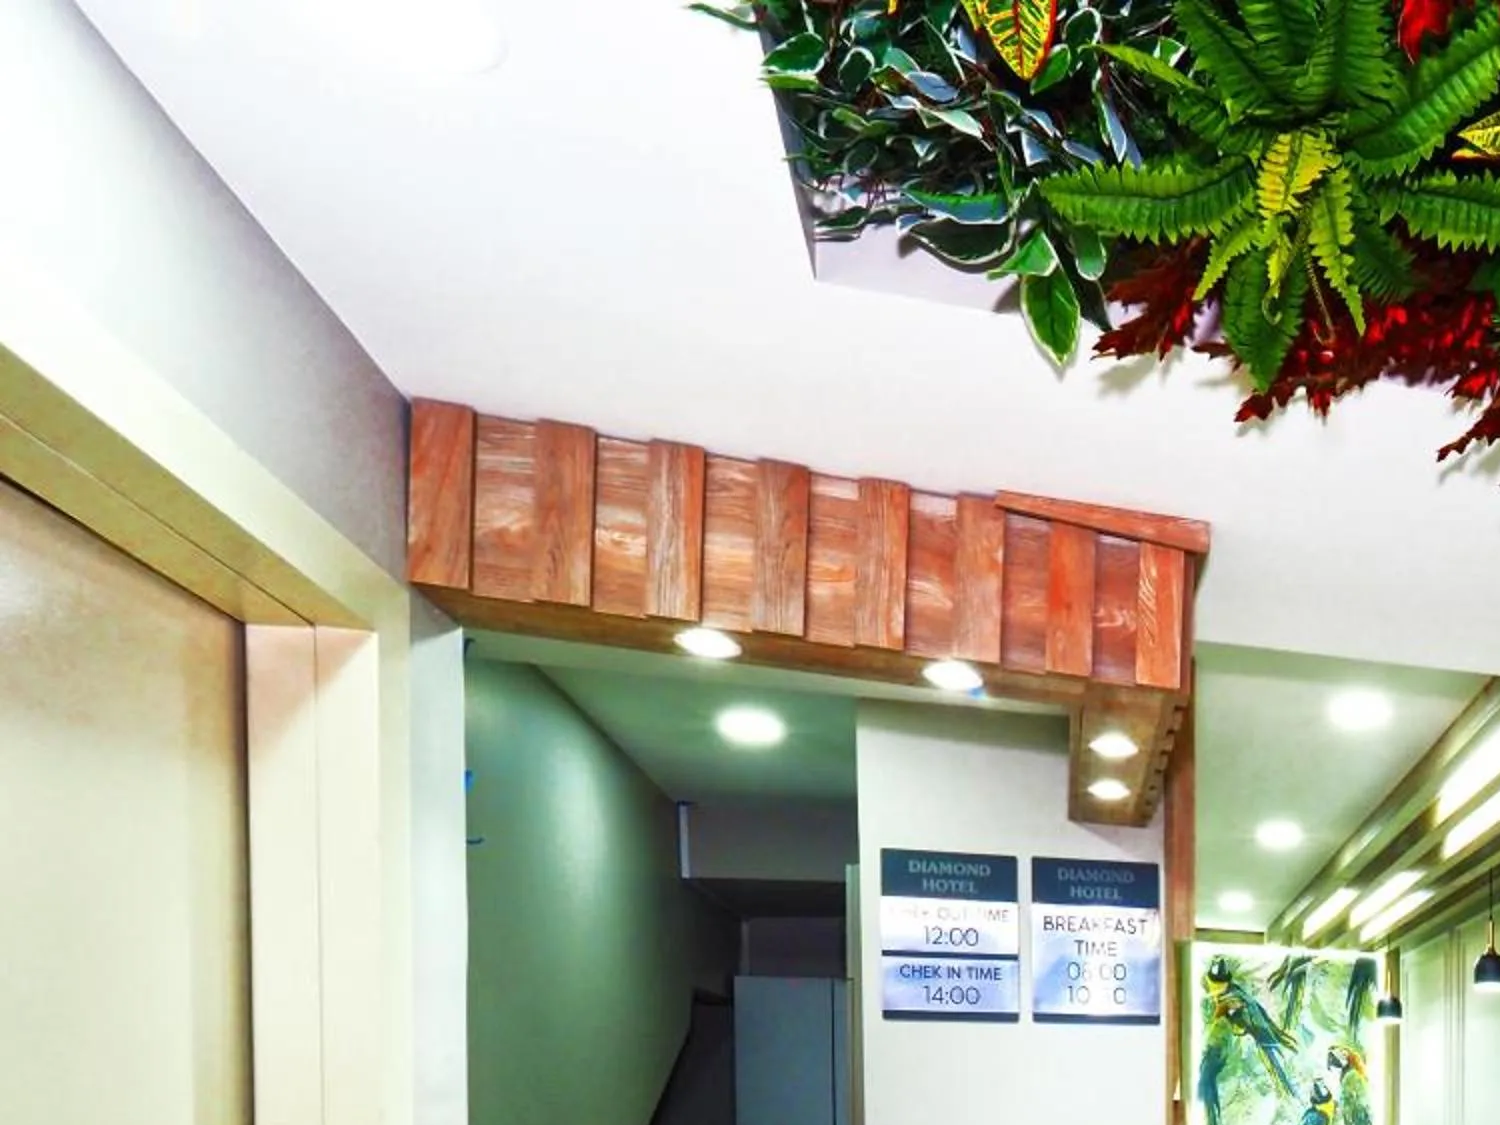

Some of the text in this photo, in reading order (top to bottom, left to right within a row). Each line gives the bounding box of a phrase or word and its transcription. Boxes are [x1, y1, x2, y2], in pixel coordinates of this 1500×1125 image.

[908, 859, 991, 877] DIAMOND
[1057, 866, 1135, 883] DIAMOND
[922, 879, 979, 894] HOTEL
[1069, 886, 1123, 901] HOTEL
[922, 925, 979, 947] 12:00
[1073, 939, 1118, 958] TIME
[899, 964, 1004, 982] CHEK IN TIME
[922, 985, 981, 1007] 14:00
